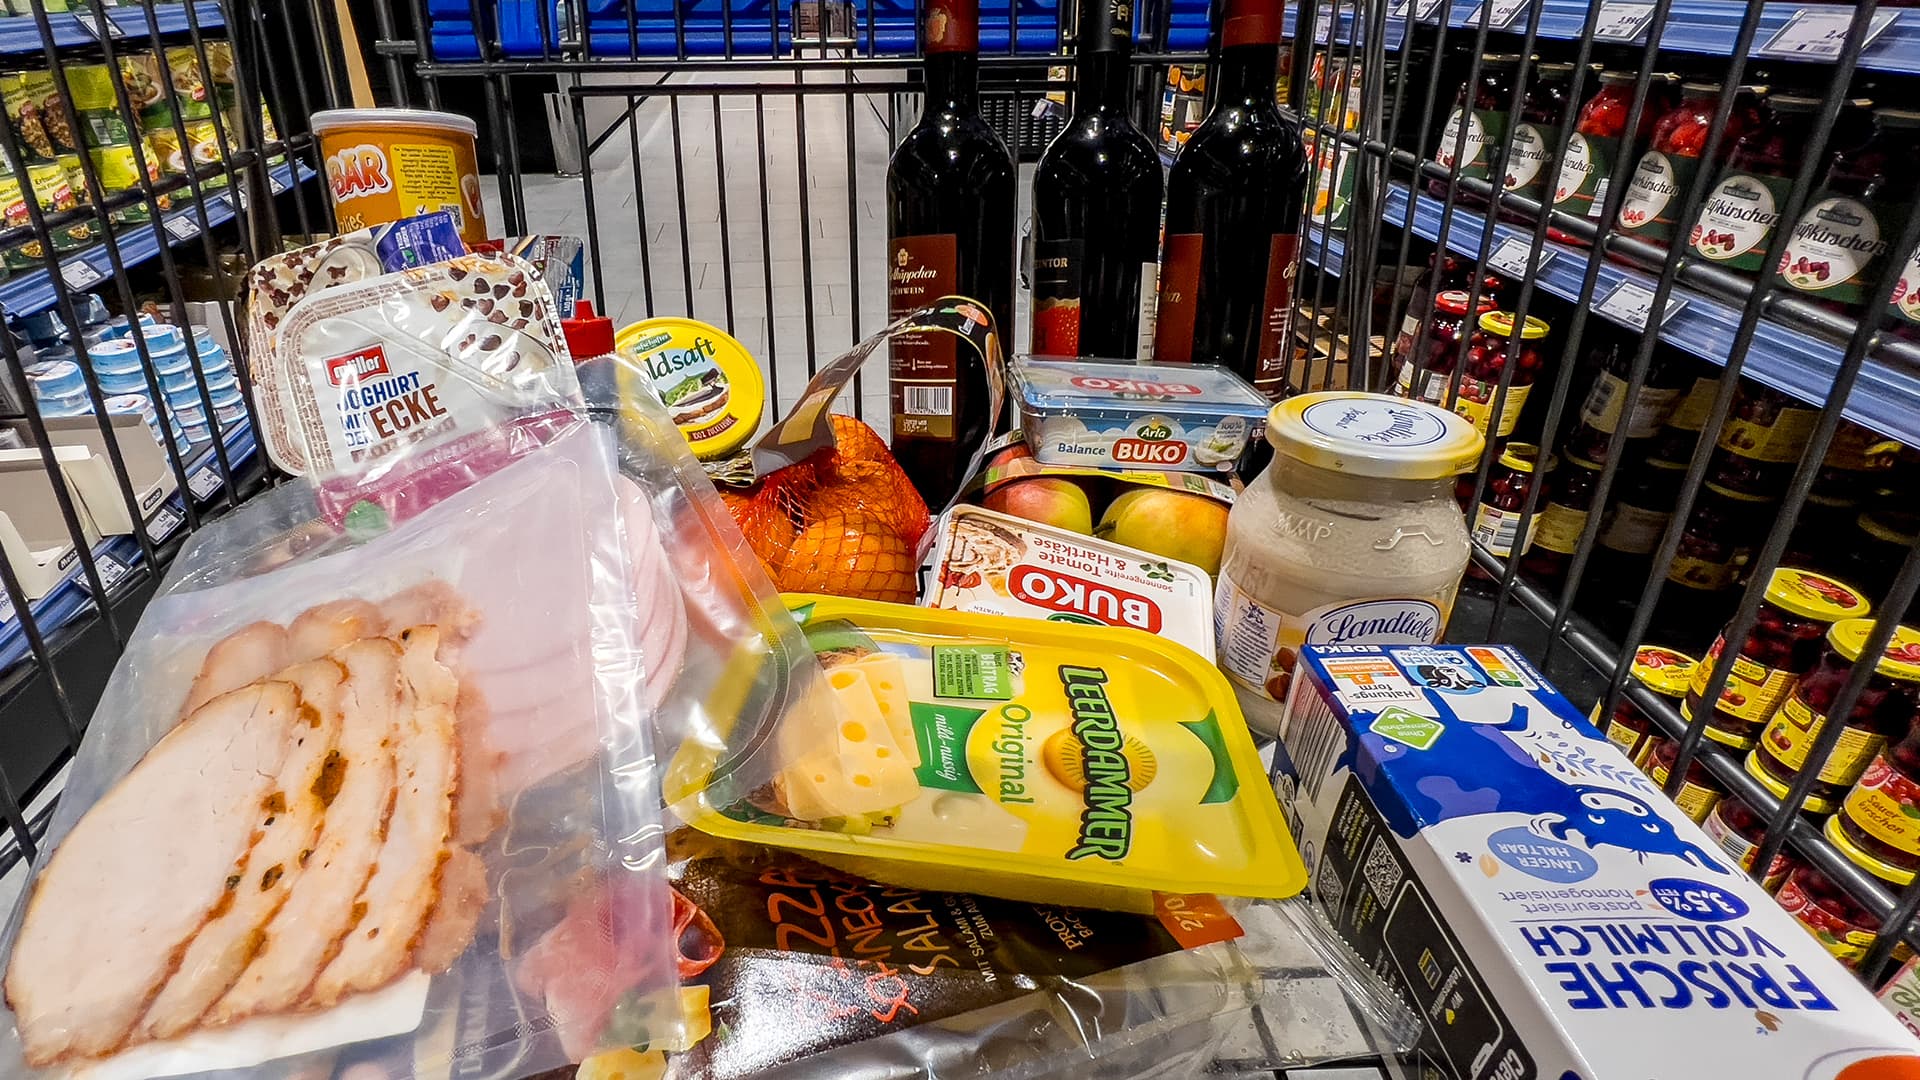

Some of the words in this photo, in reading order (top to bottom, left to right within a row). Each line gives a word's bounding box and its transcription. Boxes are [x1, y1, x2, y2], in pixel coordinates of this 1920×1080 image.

[645, 336, 716, 381] ldsaft
[337, 371, 421, 411] JOGHURT
[370, 383, 447, 440] ECKE
[1140, 427, 1167, 440] Arla
[1057, 442, 1106, 457] Balance
[1117, 442, 1182, 463] BUKO
[1033, 536, 1110, 568] Hartkäse
[1038, 550, 1103, 578] Tomate
[1113, 558, 1127, 571] &
[1103, 567, 1174, 594] Sonnengereifte
[1021, 571, 1149, 630] BUKO
[1326, 608, 1434, 643] Landliebe
[1311, 645, 1383, 654] EDEKA
[980, 653, 999, 694] BEITRAG
[1348, 690, 1416, 701] Haltungs-
[1358, 683, 1393, 692] form
[1378, 723, 1436, 732] Gentechnik
[1397, 730, 1426, 738] Ohne
[934, 712, 962, 781] mild-nussig
[991, 703, 1035, 805] Original
[1058, 664, 1133, 861] LEERDAMMER
[1857, 801, 1906, 835] kirschen
[1866, 794, 1907, 823] Sauer-
[1496, 842, 1572, 858] HALTBAR
[1517, 856, 1584, 873] LÄNGER
[1497, 888, 1636, 902] homogenisiert
[1653, 887, 1680, 896] FETT
[1660, 889, 1738, 915] 3,5%
[951, 907, 963, 917] &
[1524, 900, 1643, 914] pasteurisiert
[955, 916, 986, 958] SALAMI
[971, 912, 995, 940] ZUM
[1520, 925, 1788, 959] VOLLMILCH
[977, 960, 998, 984] MIT
[1545, 960, 1840, 1012] FRISCHE
